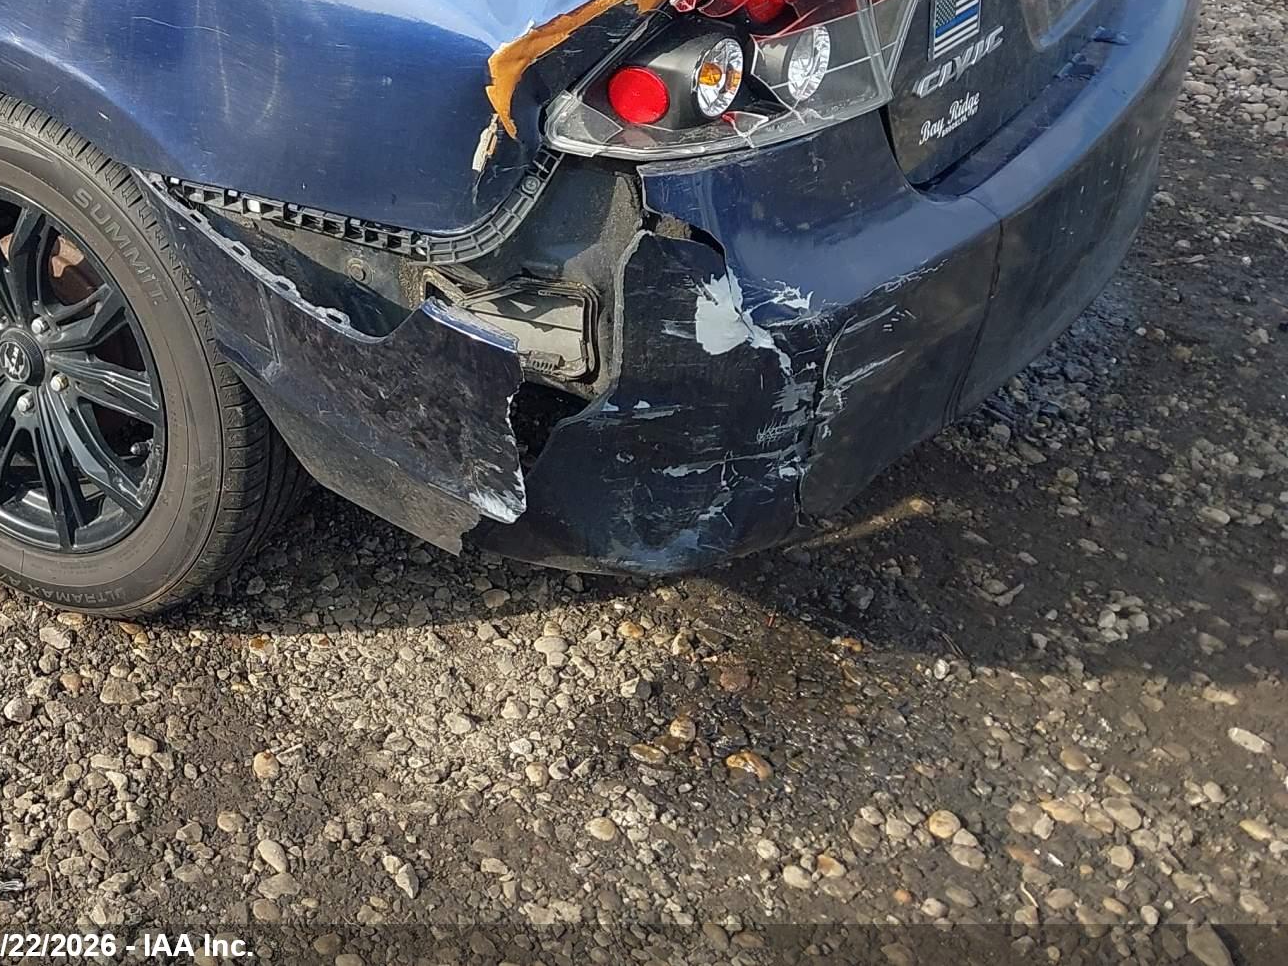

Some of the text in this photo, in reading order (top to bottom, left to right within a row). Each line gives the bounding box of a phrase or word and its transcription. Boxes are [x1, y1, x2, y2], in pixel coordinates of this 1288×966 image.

[912, 25, 1003, 98] CIVIC
[919, 92, 980, 145] Bay Ridge
[72, 187, 169, 302] SUMMIT
[27, 585, 125, 604] ULTRAMAX
